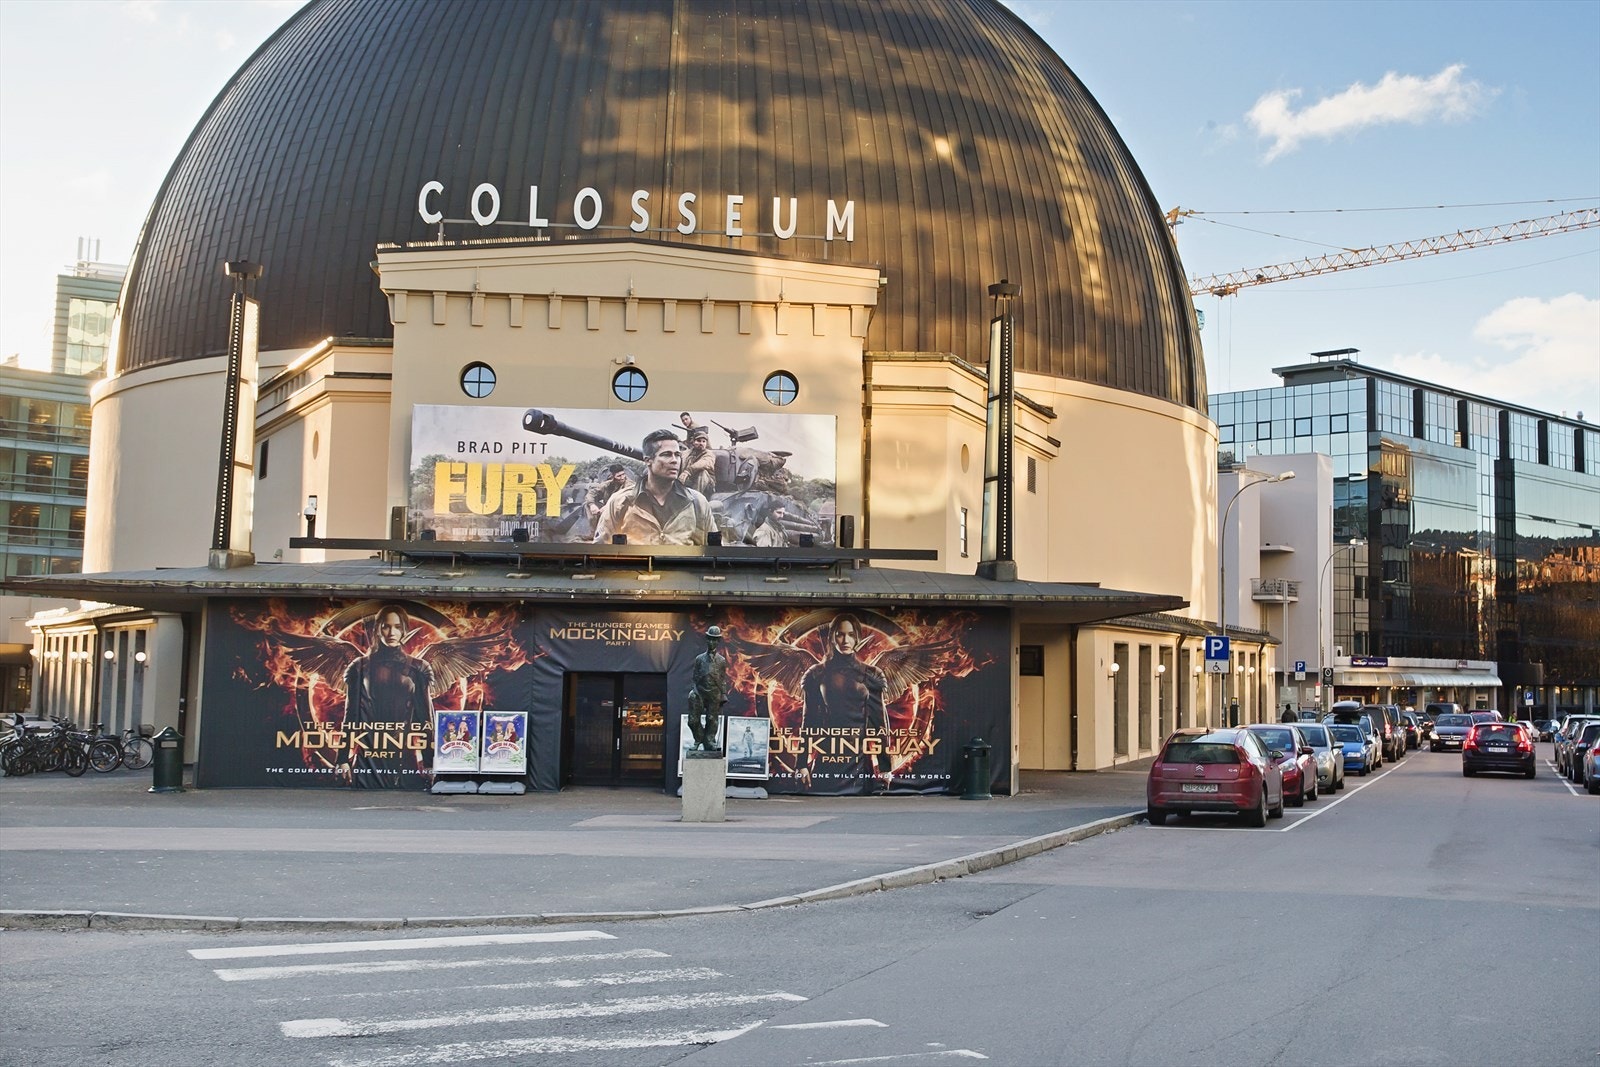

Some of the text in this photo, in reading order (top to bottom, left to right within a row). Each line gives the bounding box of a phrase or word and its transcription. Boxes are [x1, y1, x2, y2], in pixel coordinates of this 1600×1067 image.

[418, 180, 855, 242] COLOSSEUM
[457, 441, 548, 454] BRAD PITT
[433, 461, 577, 518] FURY
[590, 621, 632, 629] HUNGER
[550, 627, 685, 641] MOCKINGJAY
[1211, 639, 1224, 658] P
[1297, 662, 1303, 671] P
[304, 721, 335, 730] THE
[341, 721, 405, 730] HUNGER
[799, 727, 861, 736] HUNGER
[866, 728, 922, 737] GAMES:
[769, 736, 941, 756] OCKINGJAY
[364, 751, 396, 759] PART
[822, 755, 852, 763] PART
